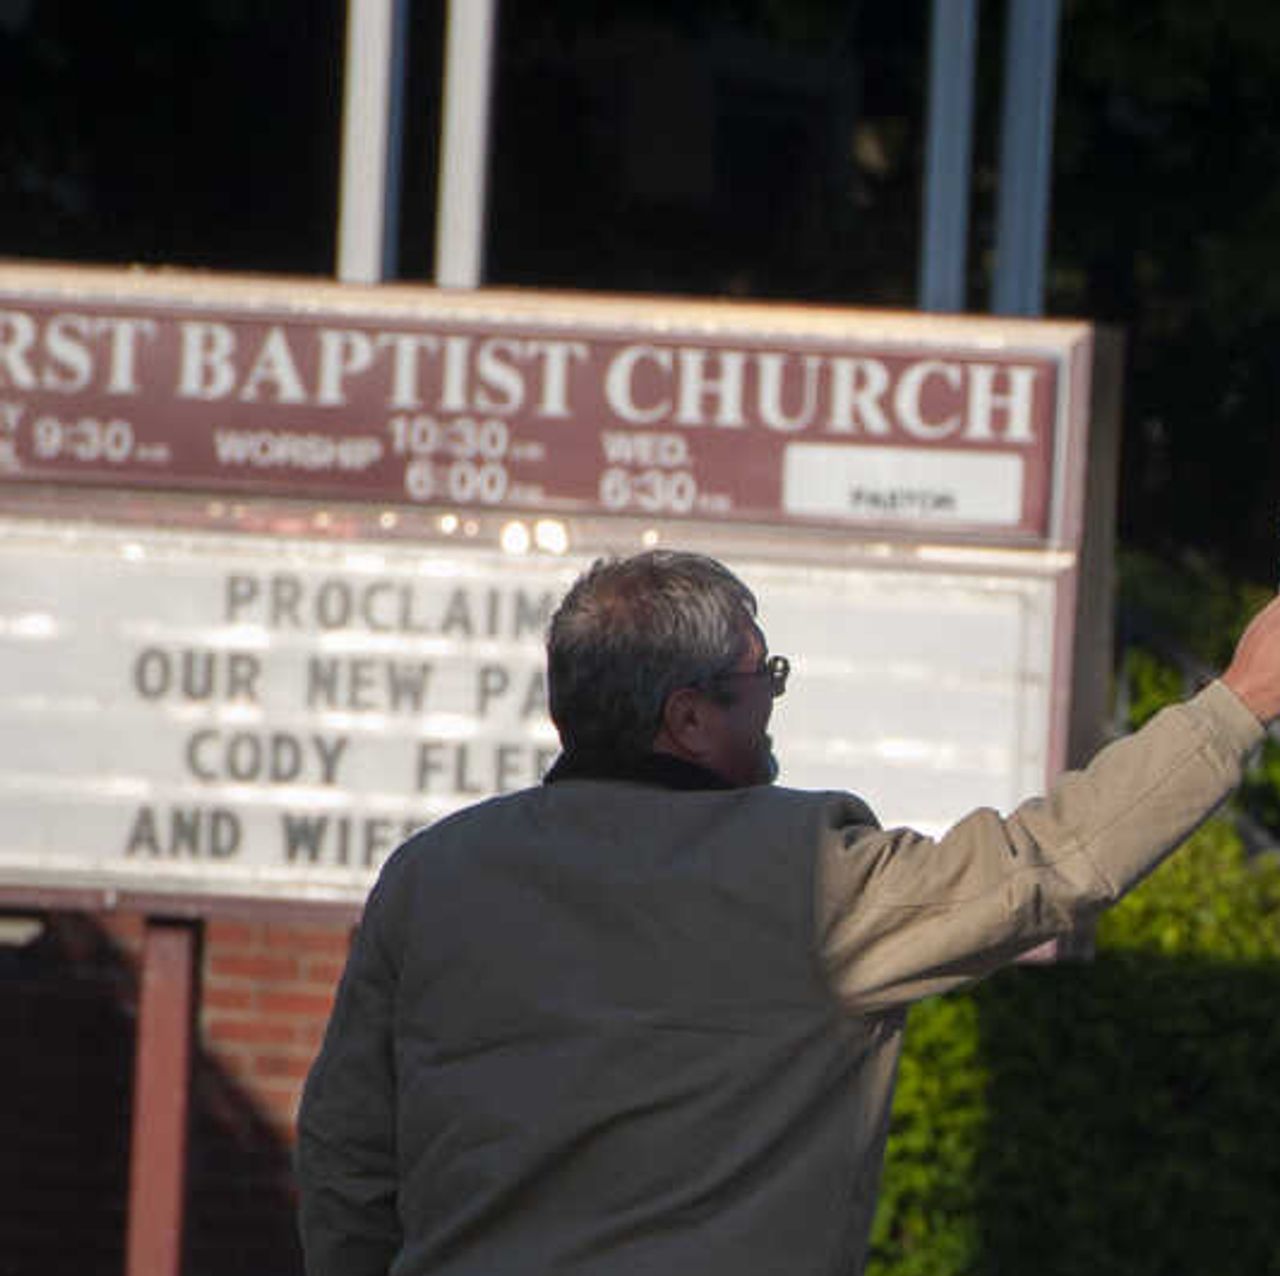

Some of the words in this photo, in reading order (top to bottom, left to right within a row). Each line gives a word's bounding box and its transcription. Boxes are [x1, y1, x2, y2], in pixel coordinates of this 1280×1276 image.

[178, 322, 588, 417] BAPTIST
[605, 344, 1036, 444] CHURCH
[33, 417, 135, 462] 9:30
[213, 428, 382, 470] WORSHIP
[390, 415, 508, 460] 10:30
[406, 460, 508, 500] 6:00
[601, 467, 698, 513] 6:30
[133, 648, 263, 702] OUR
[305, 657, 432, 712] NEW
[185, 729, 349, 785] CODY
[124, 806, 242, 858] AND
[282, 815, 418, 869] WIF
